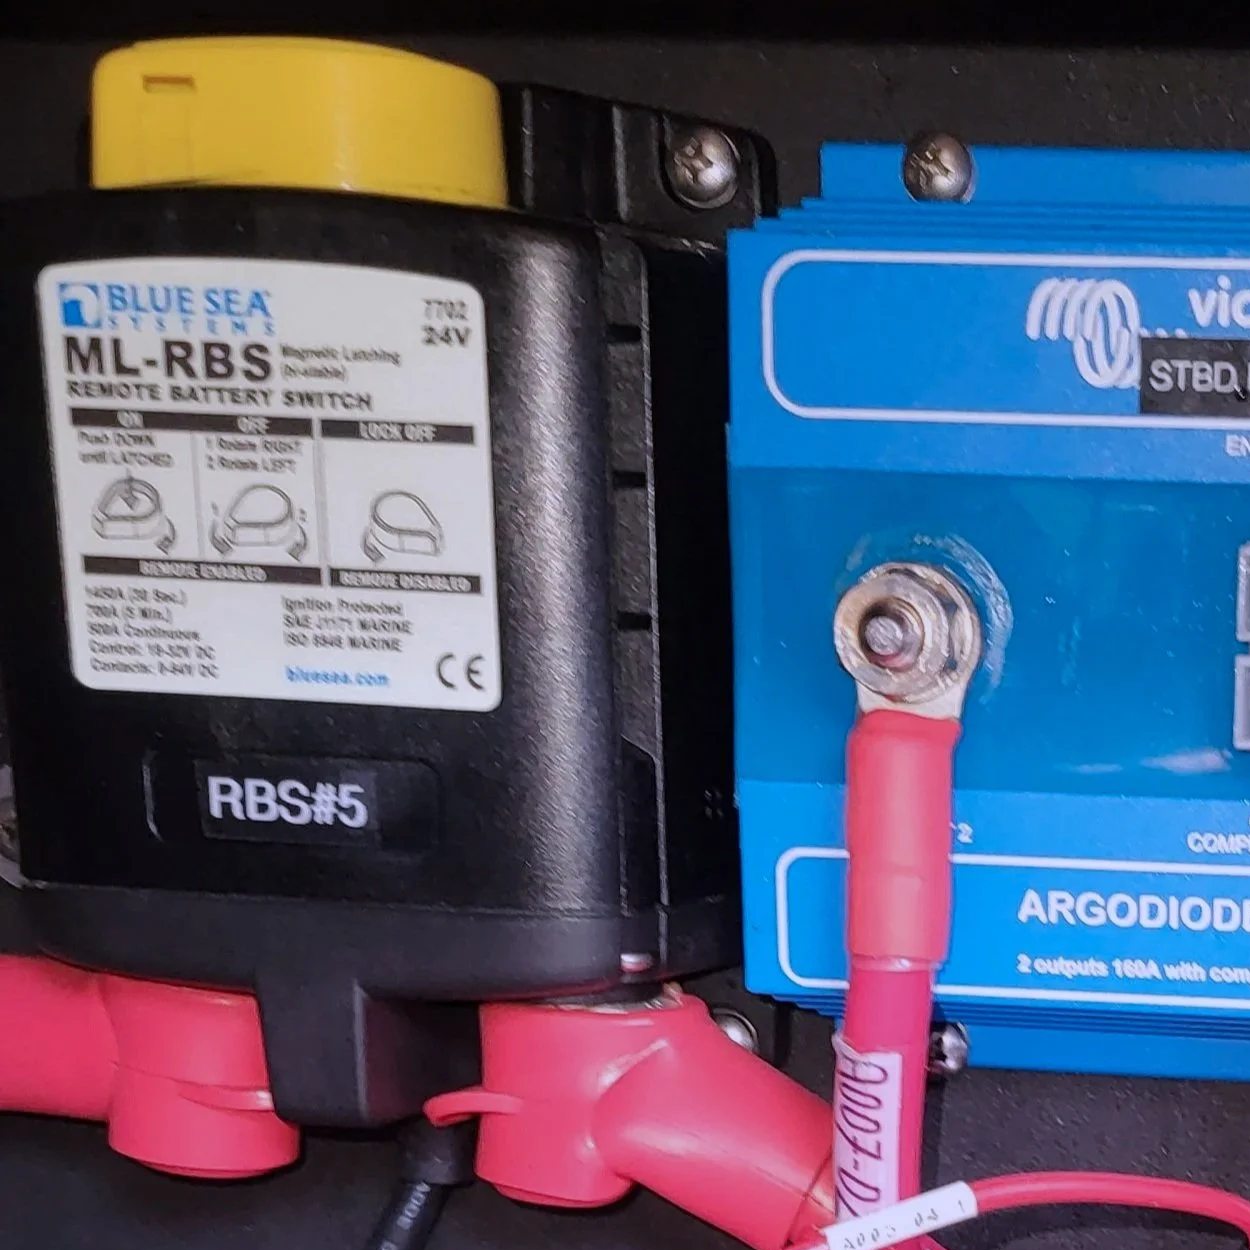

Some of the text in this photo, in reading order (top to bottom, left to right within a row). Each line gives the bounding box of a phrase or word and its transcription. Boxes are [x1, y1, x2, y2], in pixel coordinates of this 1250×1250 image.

[107, 284, 271, 318] BLUE SEA
[108, 316, 275, 336] SYSTEMS
[422, 326, 470, 347] 24V
[65, 336, 272, 381] ML-RBS
[1149, 358, 1238, 396] STBD
[67, 381, 373, 411] REMOTE BATTERY SWITCH
[208, 776, 368, 828] RBS#5
[1017, 953, 1030, 973] 2
[1033, 955, 1109, 981] outputs
[1165, 959, 1206, 983] with
